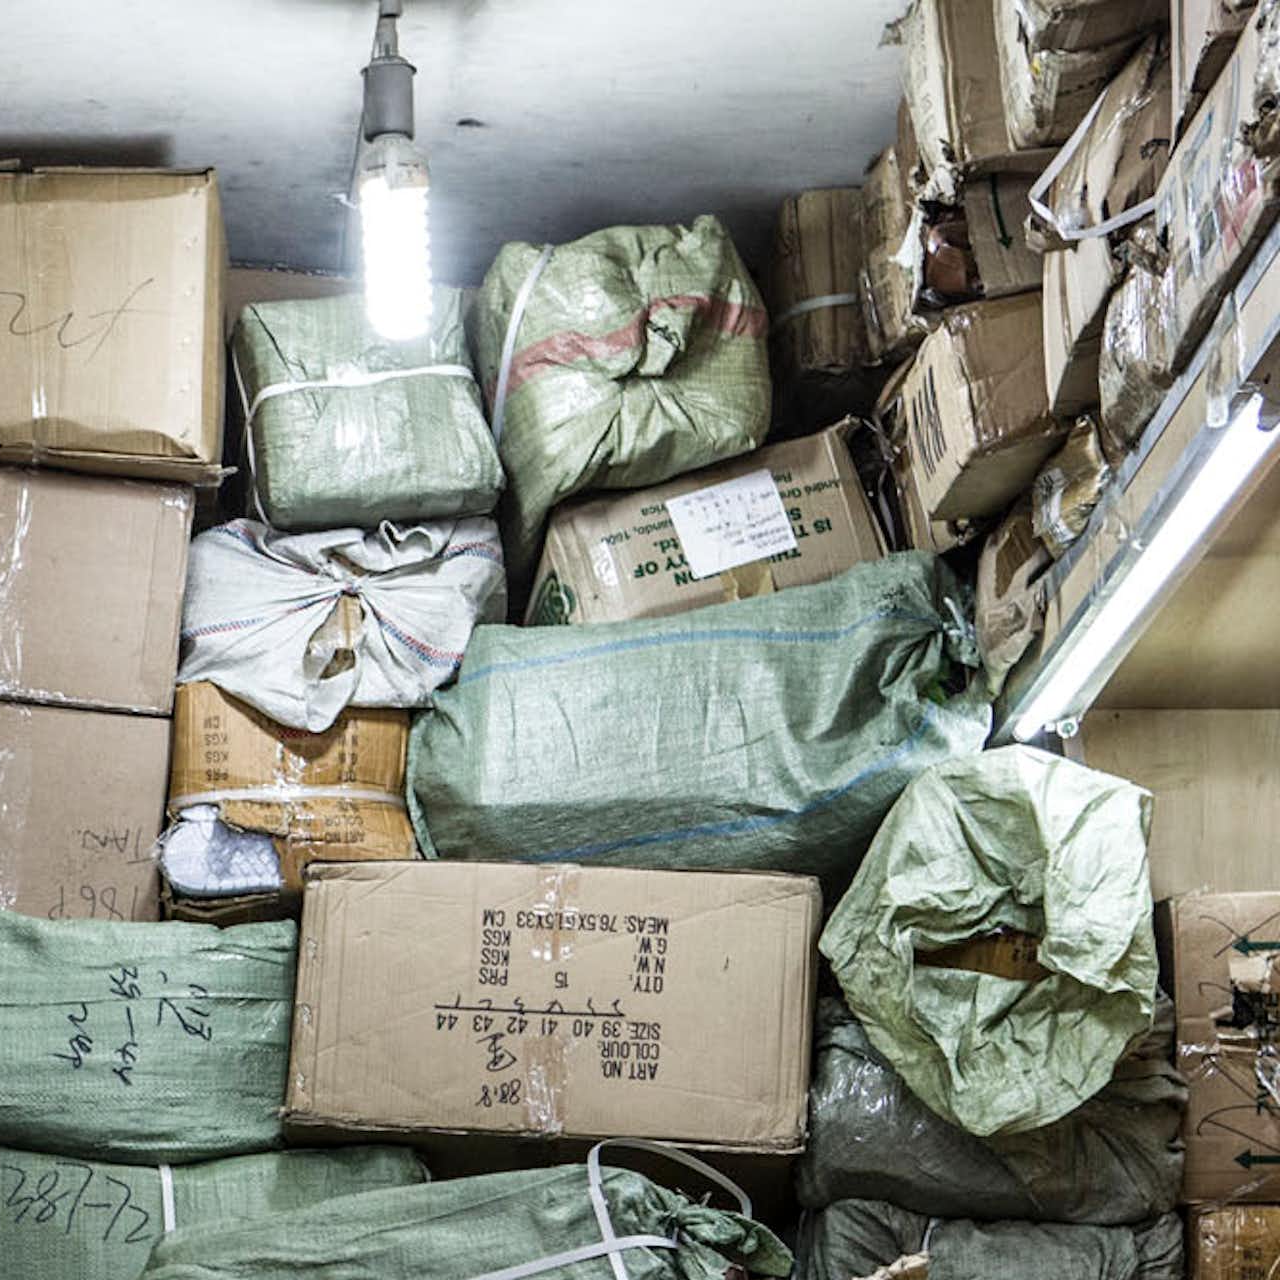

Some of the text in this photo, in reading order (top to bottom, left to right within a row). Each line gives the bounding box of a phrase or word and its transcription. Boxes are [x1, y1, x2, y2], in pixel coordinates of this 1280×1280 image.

[813, 518, 832, 536] IS
[633, 560, 659, 578] OF
[482, 909, 505, 928] CM
[623, 914, 669, 936] MEAS:
[481, 928, 512, 946] KGS
[479, 947, 510, 966] KGS
[478, 967, 509, 986] PRS
[554, 971, 569, 989] 15
[436, 1012, 662, 1040] SIZE: 39 40 41 42 43 44
